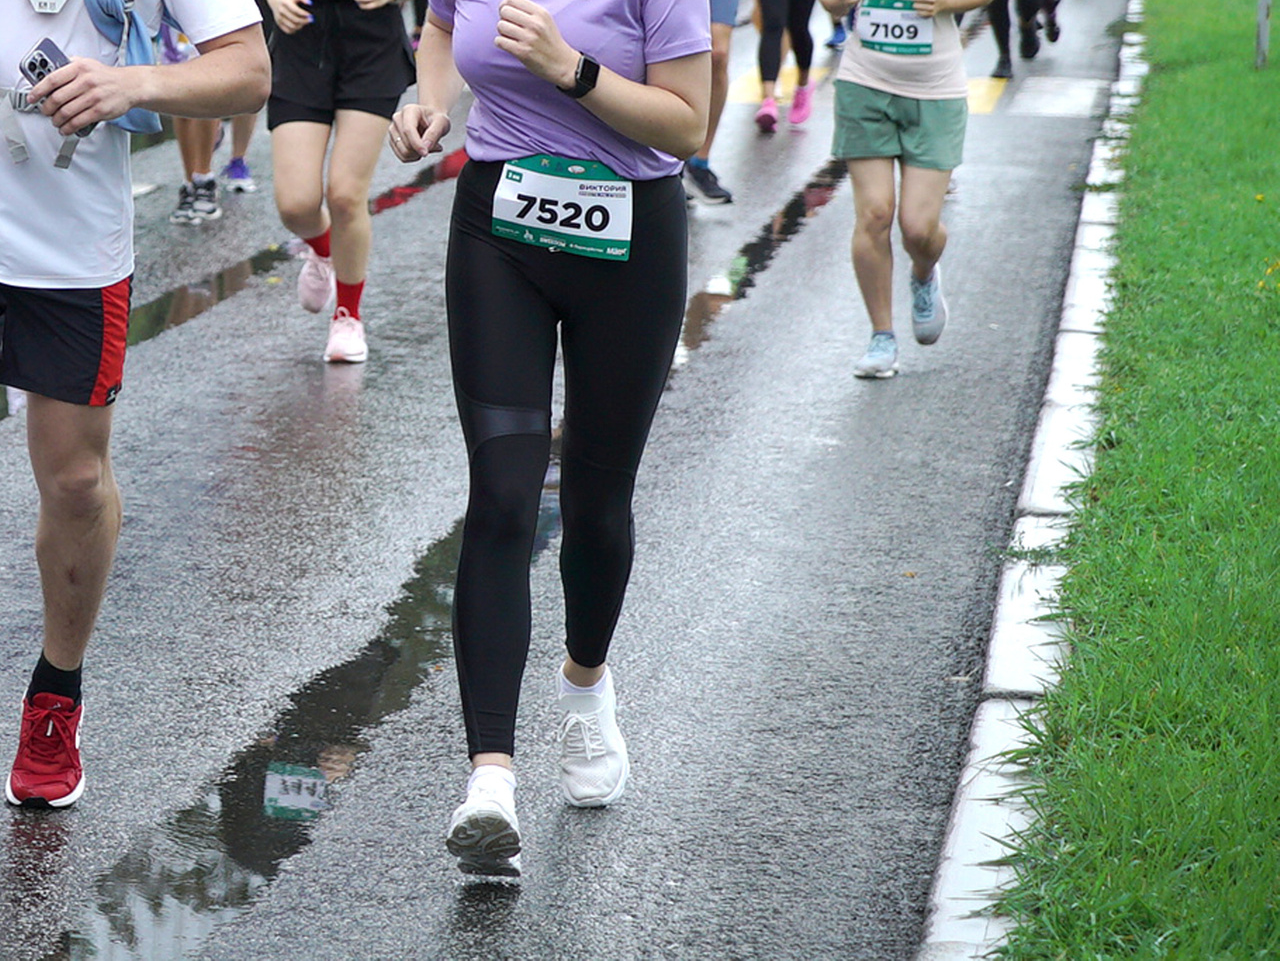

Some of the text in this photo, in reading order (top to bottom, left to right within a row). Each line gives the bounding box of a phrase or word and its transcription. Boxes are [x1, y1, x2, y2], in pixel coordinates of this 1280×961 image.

[870, 22, 918, 40] 7109
[579, 184, 627, 192] ВИКТОРИЯ
[516, 193, 610, 232] 7520
